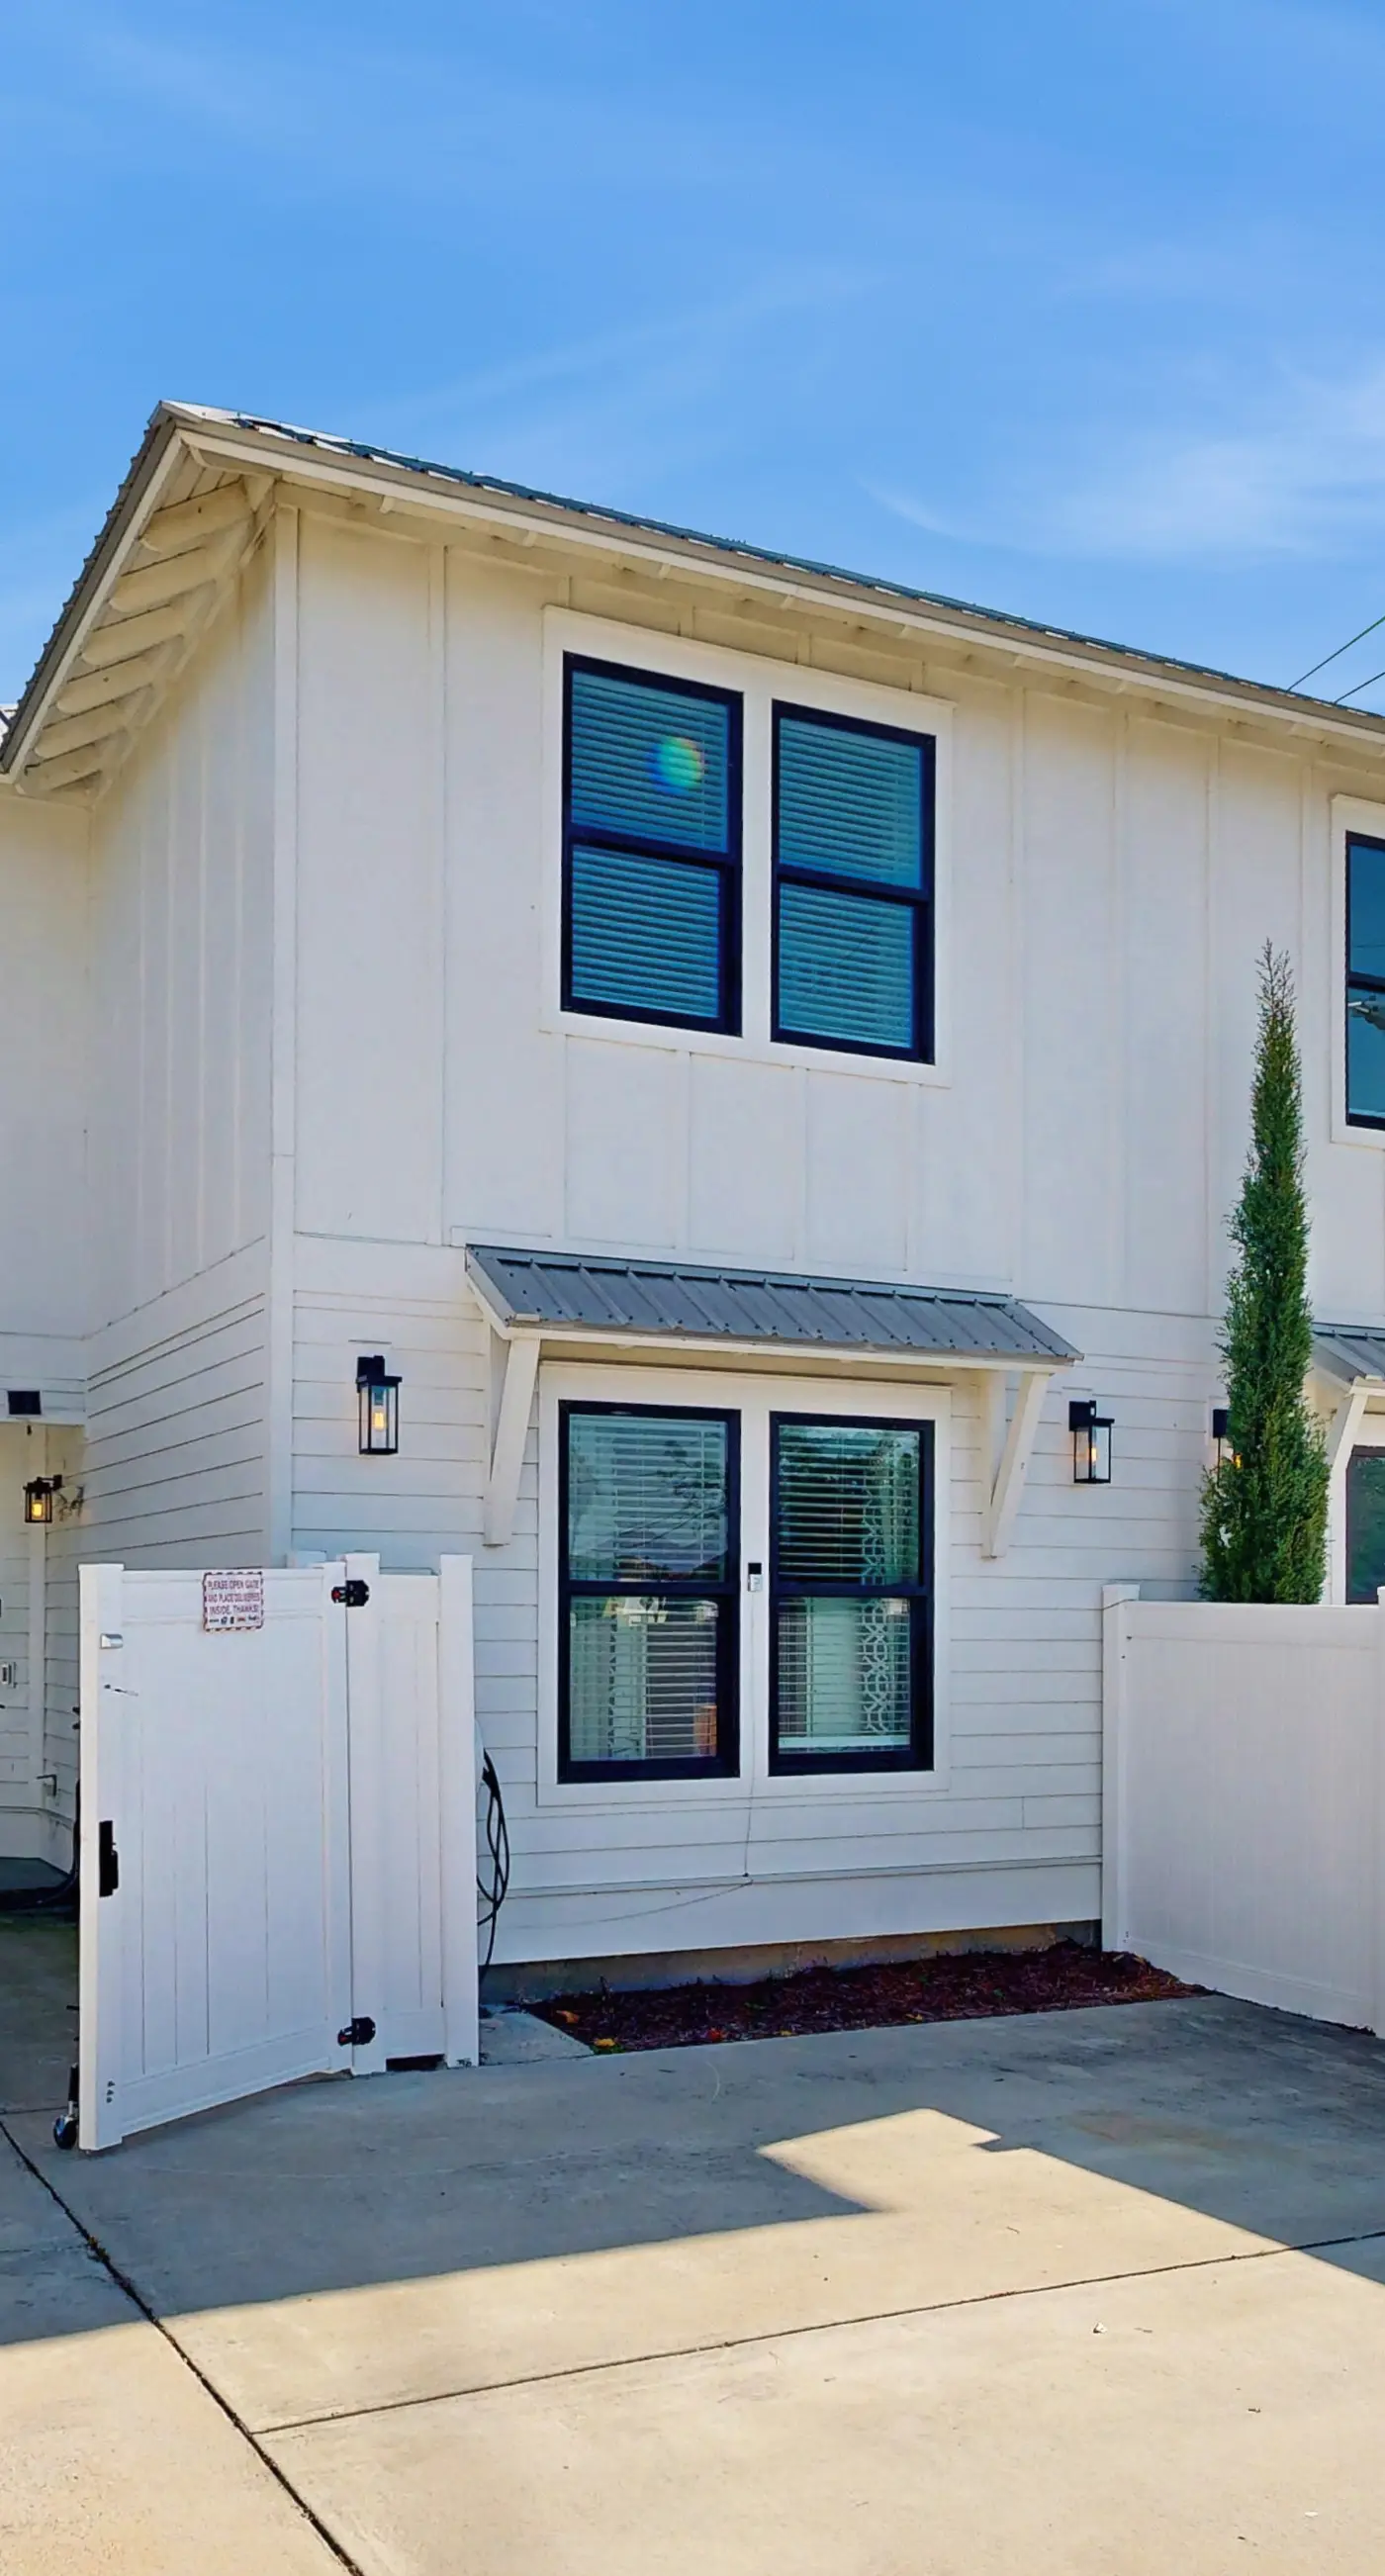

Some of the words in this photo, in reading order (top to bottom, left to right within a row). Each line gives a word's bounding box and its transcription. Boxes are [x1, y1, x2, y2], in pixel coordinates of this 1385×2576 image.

[207, 1580, 229, 1590] PLEASE
[230, 1580, 243, 1589] OPEN
[245, 1579, 259, 1589] GATE
